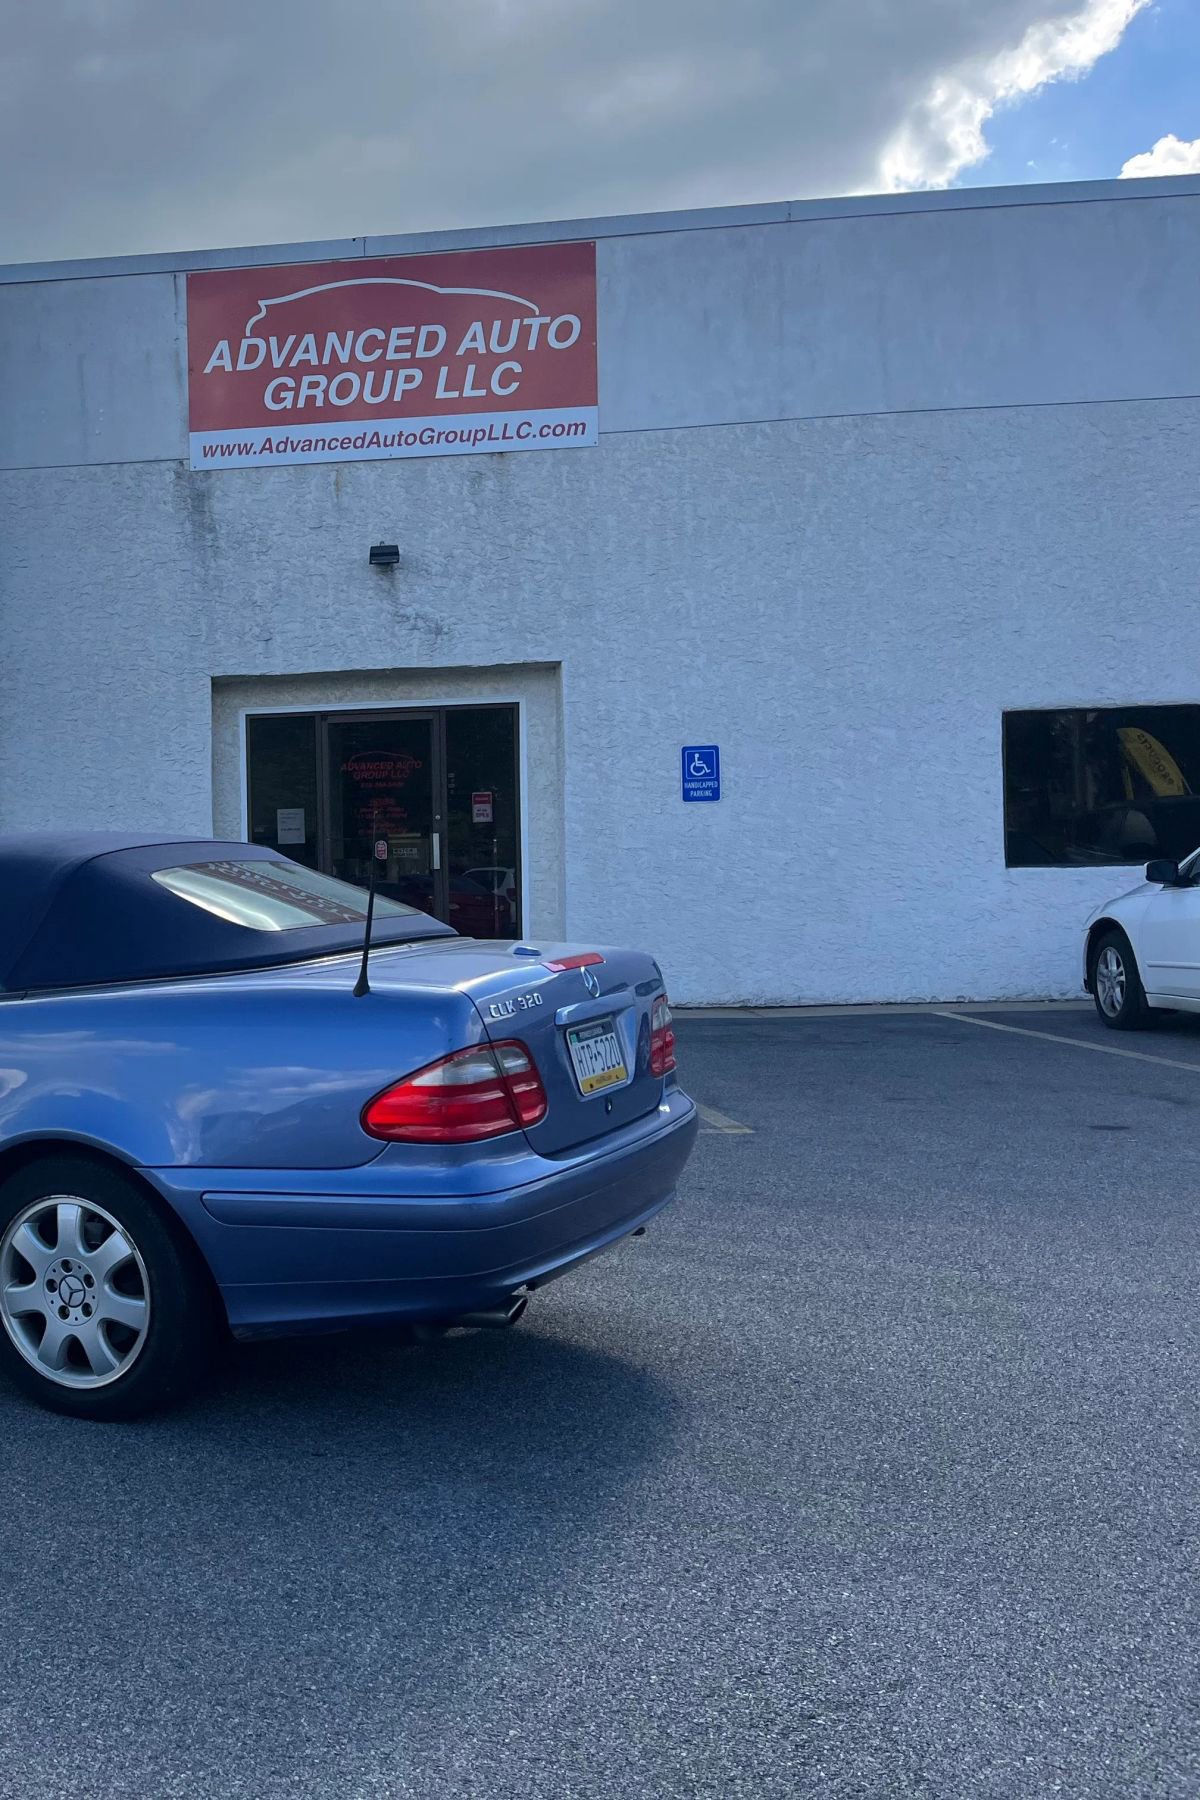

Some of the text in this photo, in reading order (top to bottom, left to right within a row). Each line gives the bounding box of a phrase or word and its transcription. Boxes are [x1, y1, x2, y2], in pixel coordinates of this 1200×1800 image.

[203, 313, 581, 374] ADVANCED AUTO
[264, 360, 523, 411] GROUP LLC
[202, 420, 587, 460] www.AdvancedAutoGroupLLC.com
[340, 759, 423, 771] ADVANCED AUTO
[353, 770, 389, 780] GROUP
[690, 789, 712, 797] PARKING
[489, 992, 543, 1018] CLK 320
